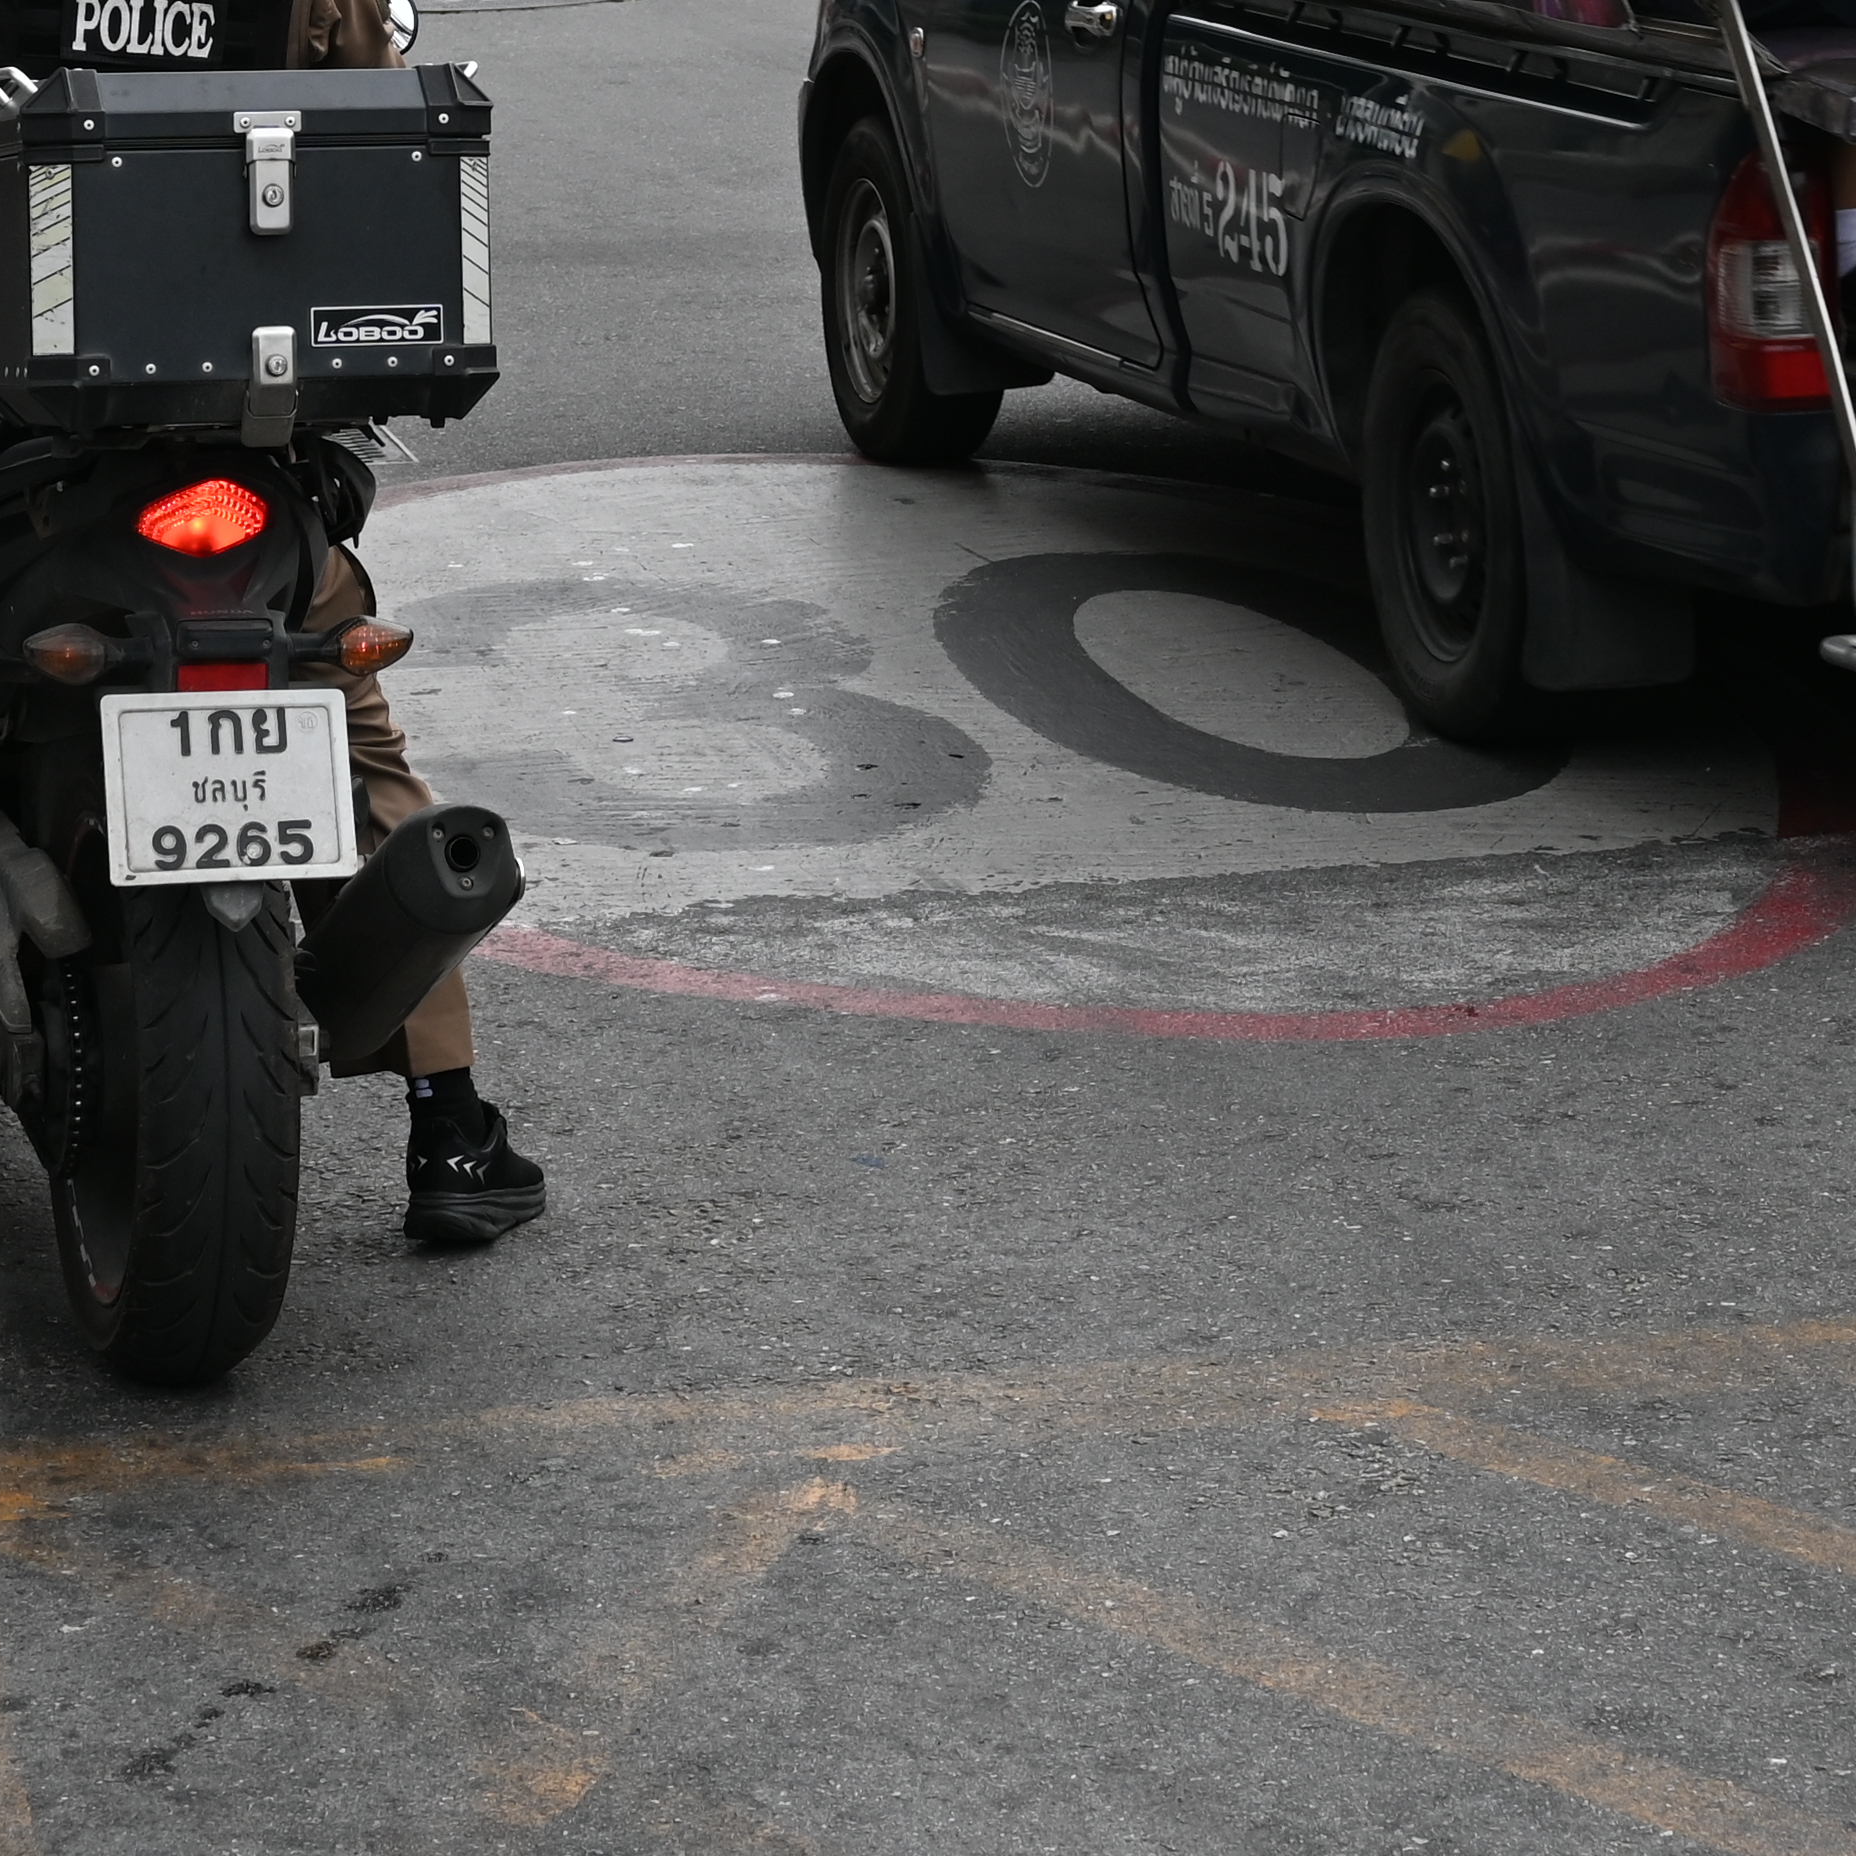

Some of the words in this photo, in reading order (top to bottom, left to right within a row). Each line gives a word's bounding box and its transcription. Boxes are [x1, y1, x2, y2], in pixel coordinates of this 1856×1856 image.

[1215, 160, 1289, 277] 245
[317, 318, 427, 343] LOBOO
[169, 706, 288, 757] 1กย
[191, 769, 267, 811] ชลบุรี
[151, 819, 315, 871] 9265
